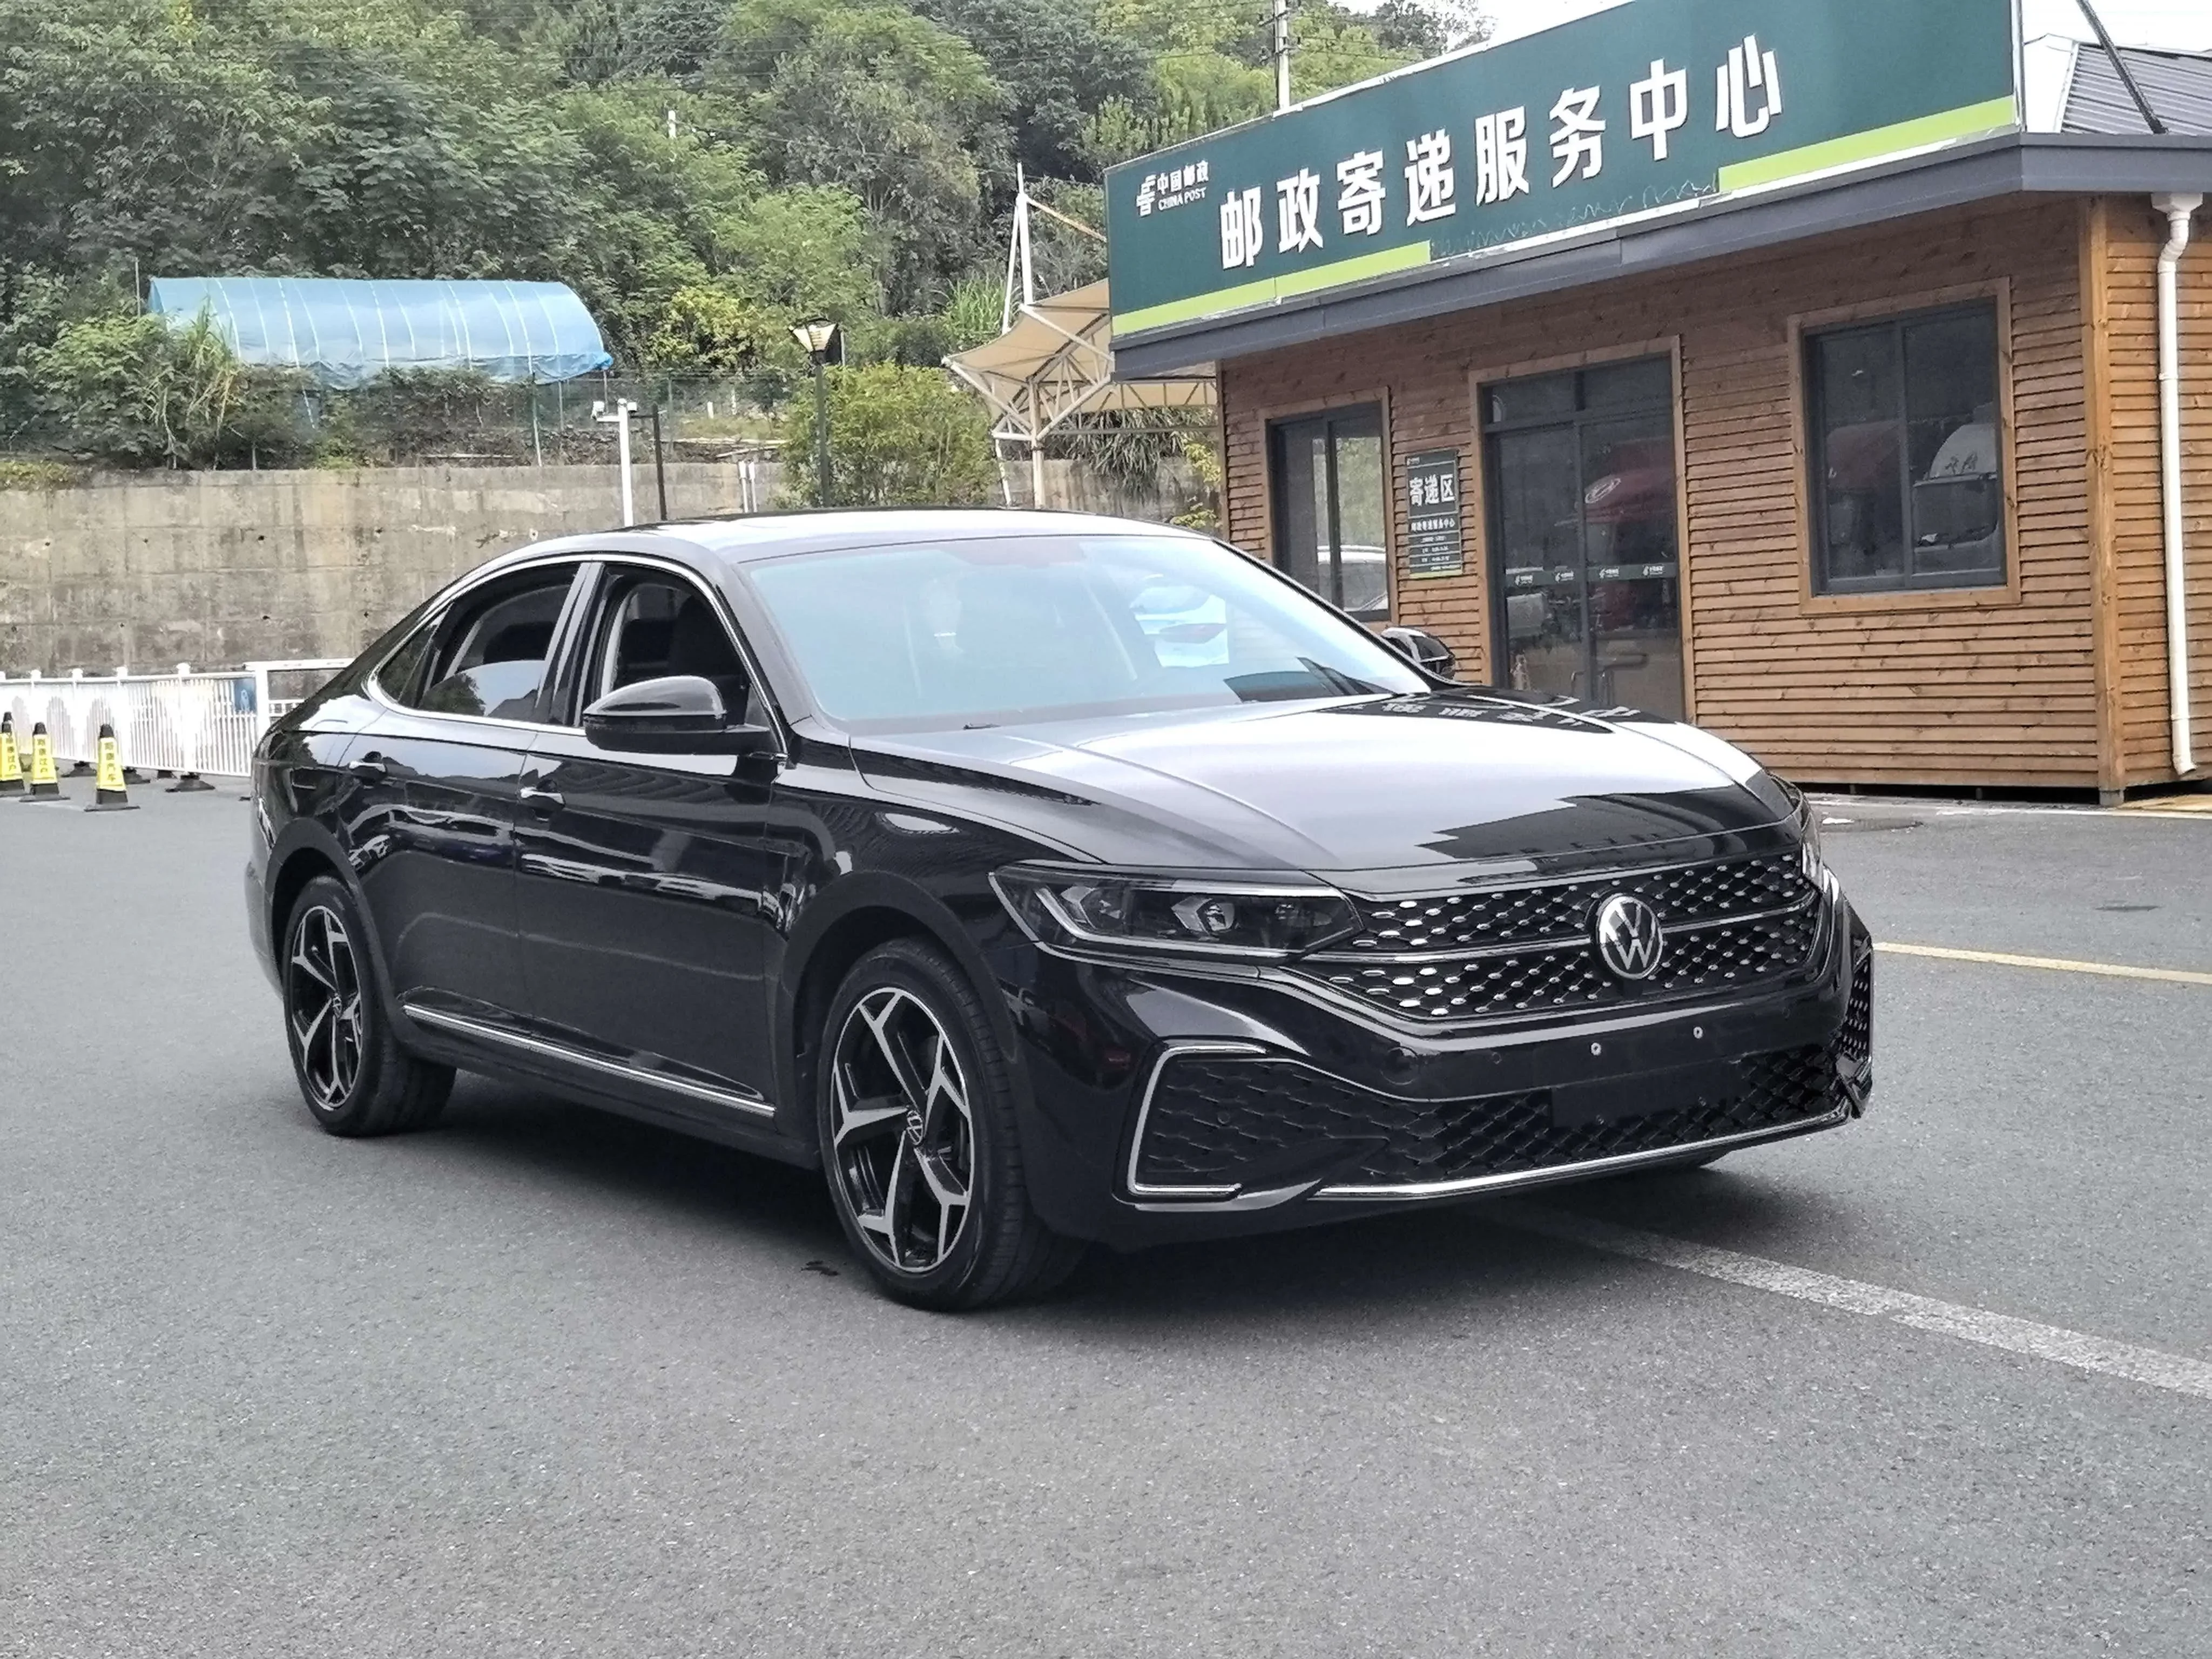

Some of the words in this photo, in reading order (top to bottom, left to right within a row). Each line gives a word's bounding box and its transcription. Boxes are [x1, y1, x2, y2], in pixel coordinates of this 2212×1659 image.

[1219, 33, 1783, 270] 邮政寄递服务中心
[1157, 160, 1209, 195] 中国邮政
[1184, 186, 1207, 204] POST
[1410, 474, 1456, 505] 寄递区
